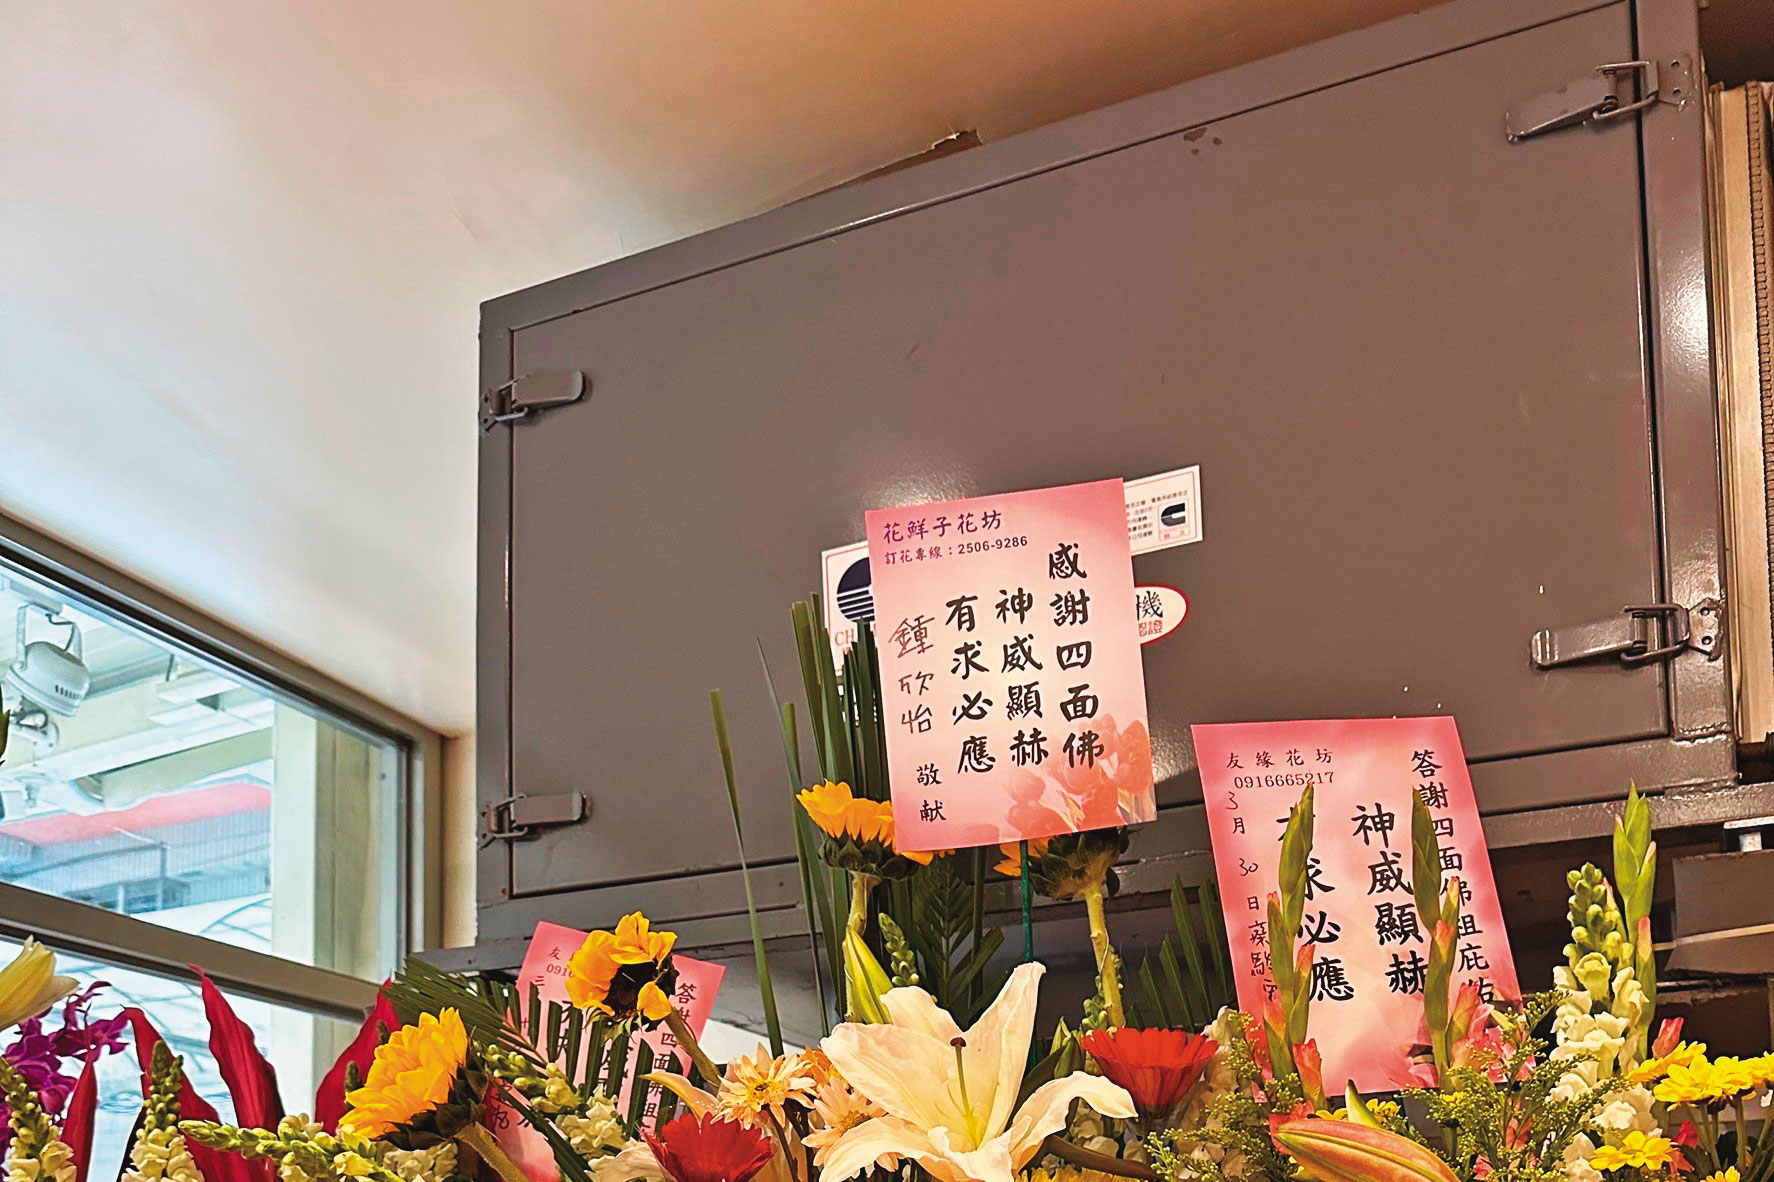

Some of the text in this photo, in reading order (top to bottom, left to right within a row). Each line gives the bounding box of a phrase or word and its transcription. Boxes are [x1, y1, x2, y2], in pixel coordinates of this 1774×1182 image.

[883, 510, 1002, 544] 花鮮子花坊
[945, 595, 996, 774] 有求必應
[995, 588, 1048, 769] 神威顯赫
[1048, 542, 1104, 769] 感謝四面佛
[1226, 748, 1333, 769] 友緣花坊
[1234, 771, 1334, 789] 0916665217
[1351, 802, 1428, 995] 神威顯赫
